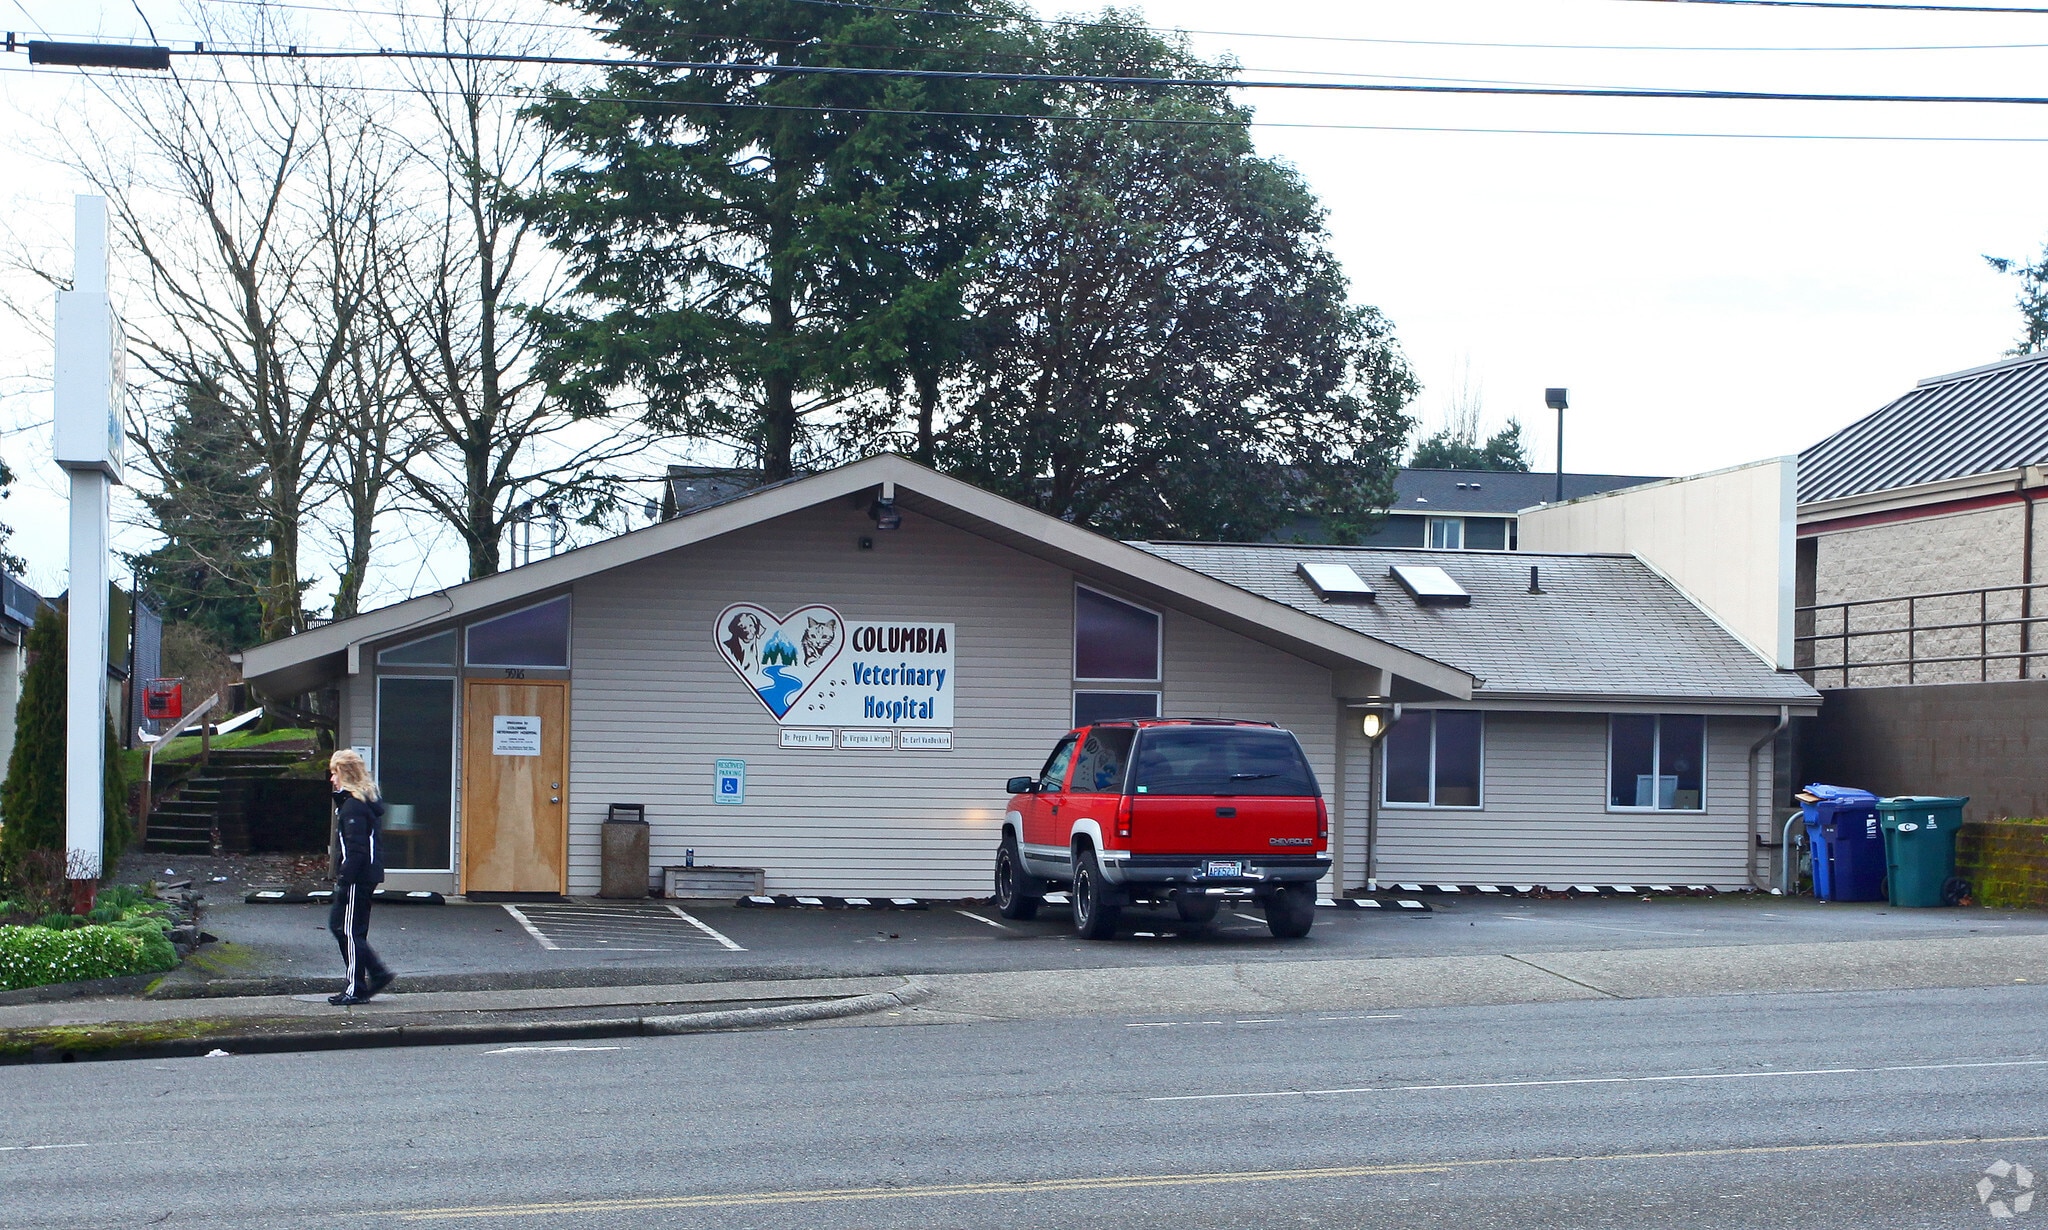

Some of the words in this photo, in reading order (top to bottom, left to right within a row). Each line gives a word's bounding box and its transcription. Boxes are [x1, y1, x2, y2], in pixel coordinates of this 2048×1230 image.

[852, 626, 948, 654] COLUMBIA
[852, 661, 947, 692] Veterinary
[864, 695, 935, 724] Hospital
[1269, 837, 1313, 846] CHEVROLET
